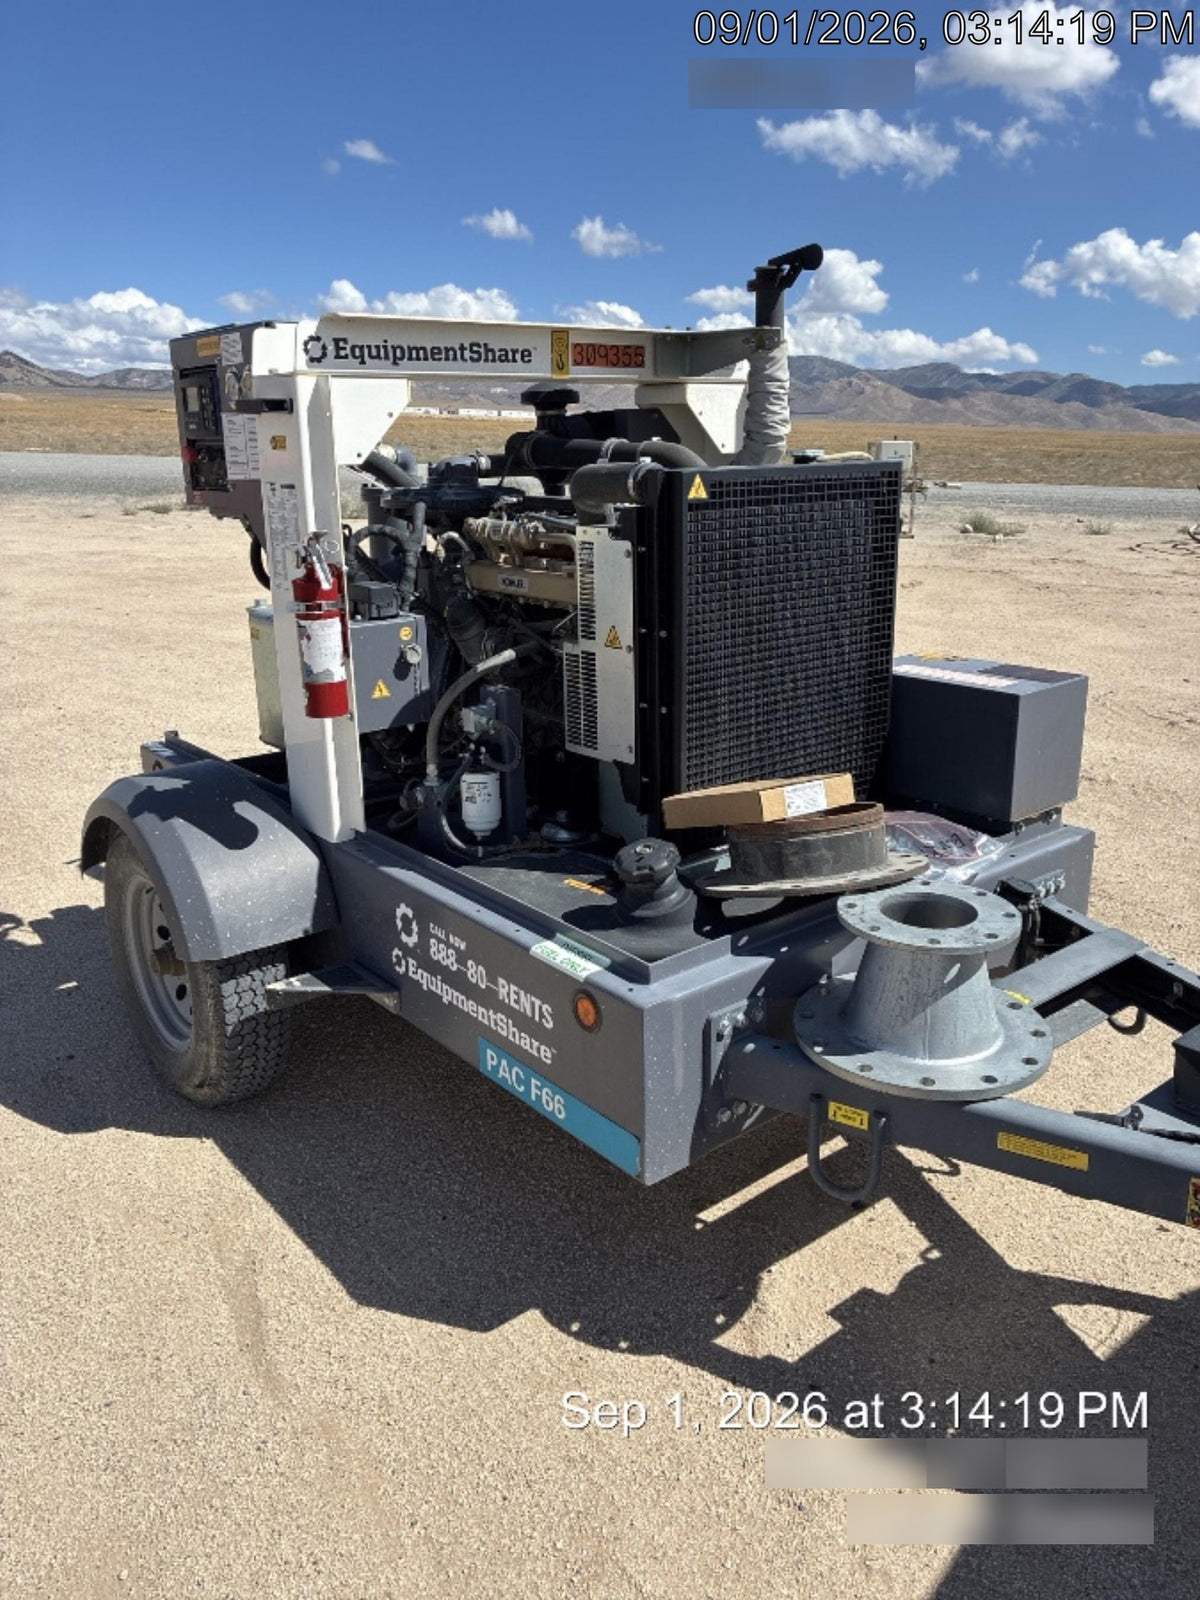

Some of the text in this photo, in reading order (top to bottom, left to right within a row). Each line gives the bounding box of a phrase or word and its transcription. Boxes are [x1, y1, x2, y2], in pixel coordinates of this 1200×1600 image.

[333, 337, 533, 366] EquipmentShare
[573, 343, 646, 367] 309355
[407, 957, 553, 1065] EquipmentShare
[486, 1048, 567, 1121] PAC F66
